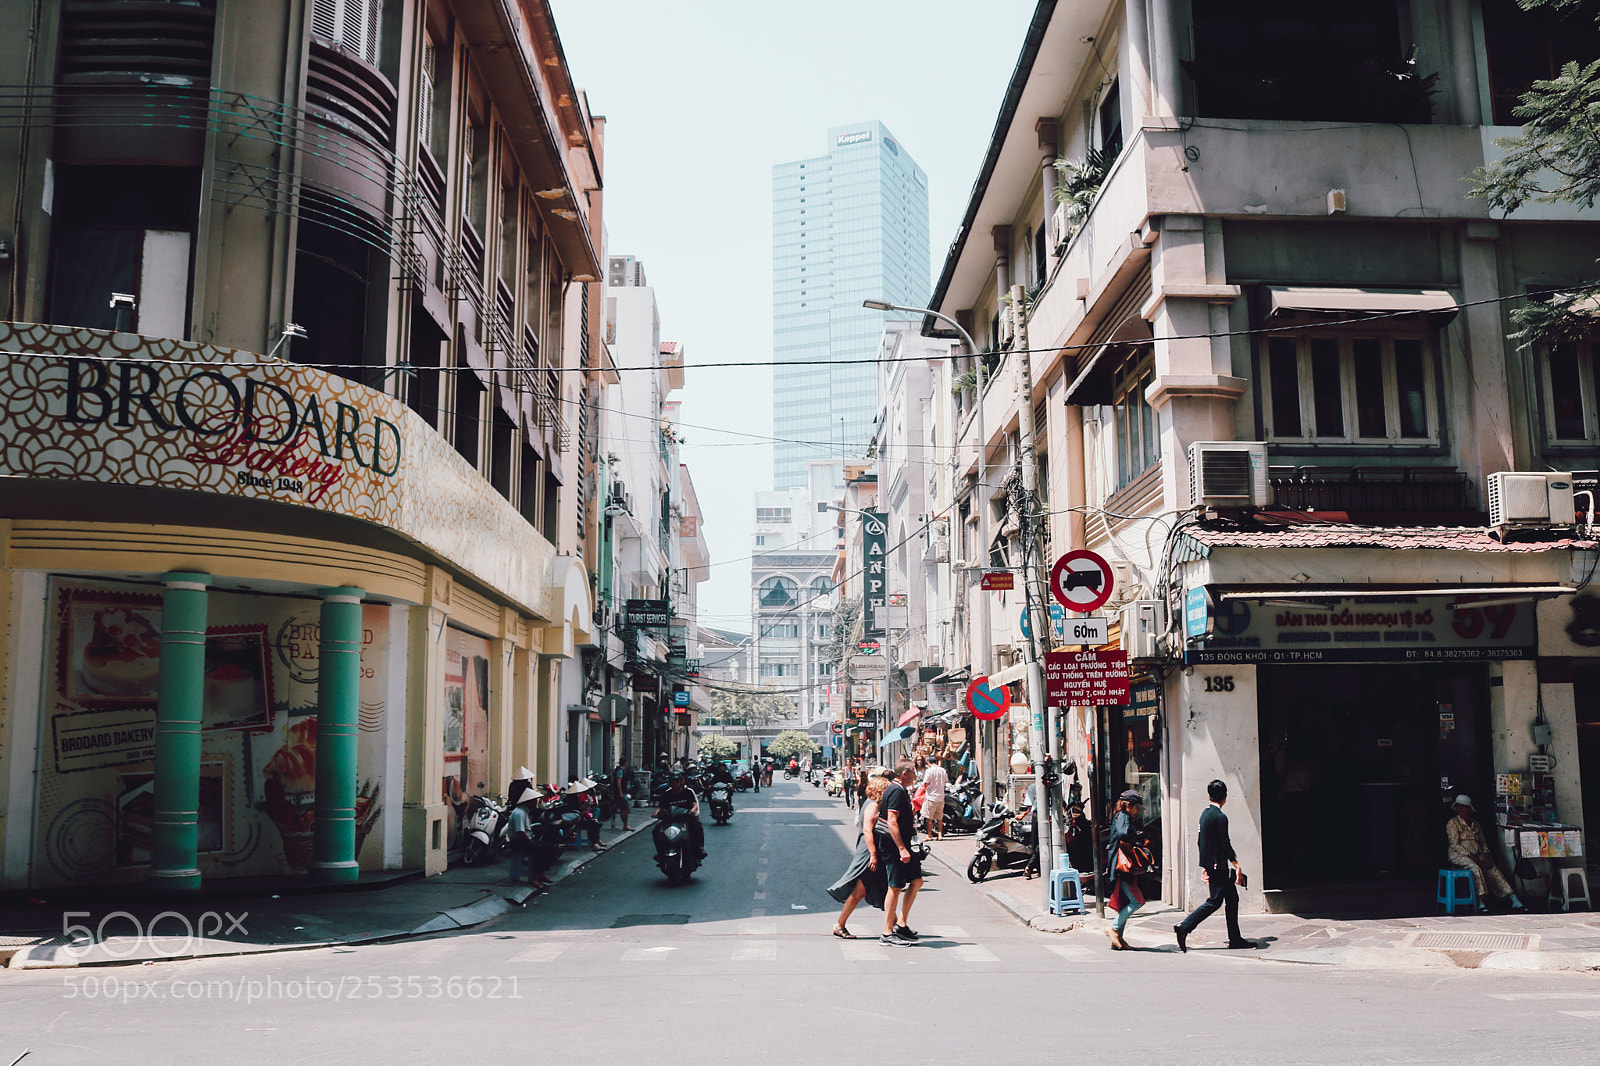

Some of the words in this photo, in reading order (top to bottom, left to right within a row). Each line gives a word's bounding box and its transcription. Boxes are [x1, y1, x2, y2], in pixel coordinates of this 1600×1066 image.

[837, 130, 870, 145] Keppel
[62, 358, 401, 477] BRODARD
[188, 410, 344, 503] Bakery
[237, 470, 272, 489] Since
[276, 477, 303, 493] 1948
[628, 613, 646, 624] TOURIST
[646, 613, 667, 624] SERVICES
[1304, 614, 1328, 626] THU
[1073, 624, 1098, 639] 60m
[1199, 653, 1215, 661] 135
[686, 660, 699, 672] SPA
[1204, 675, 1234, 692] 135
[61, 732, 112, 753] BRODARD
[114, 727, 154, 746] BAKERY
